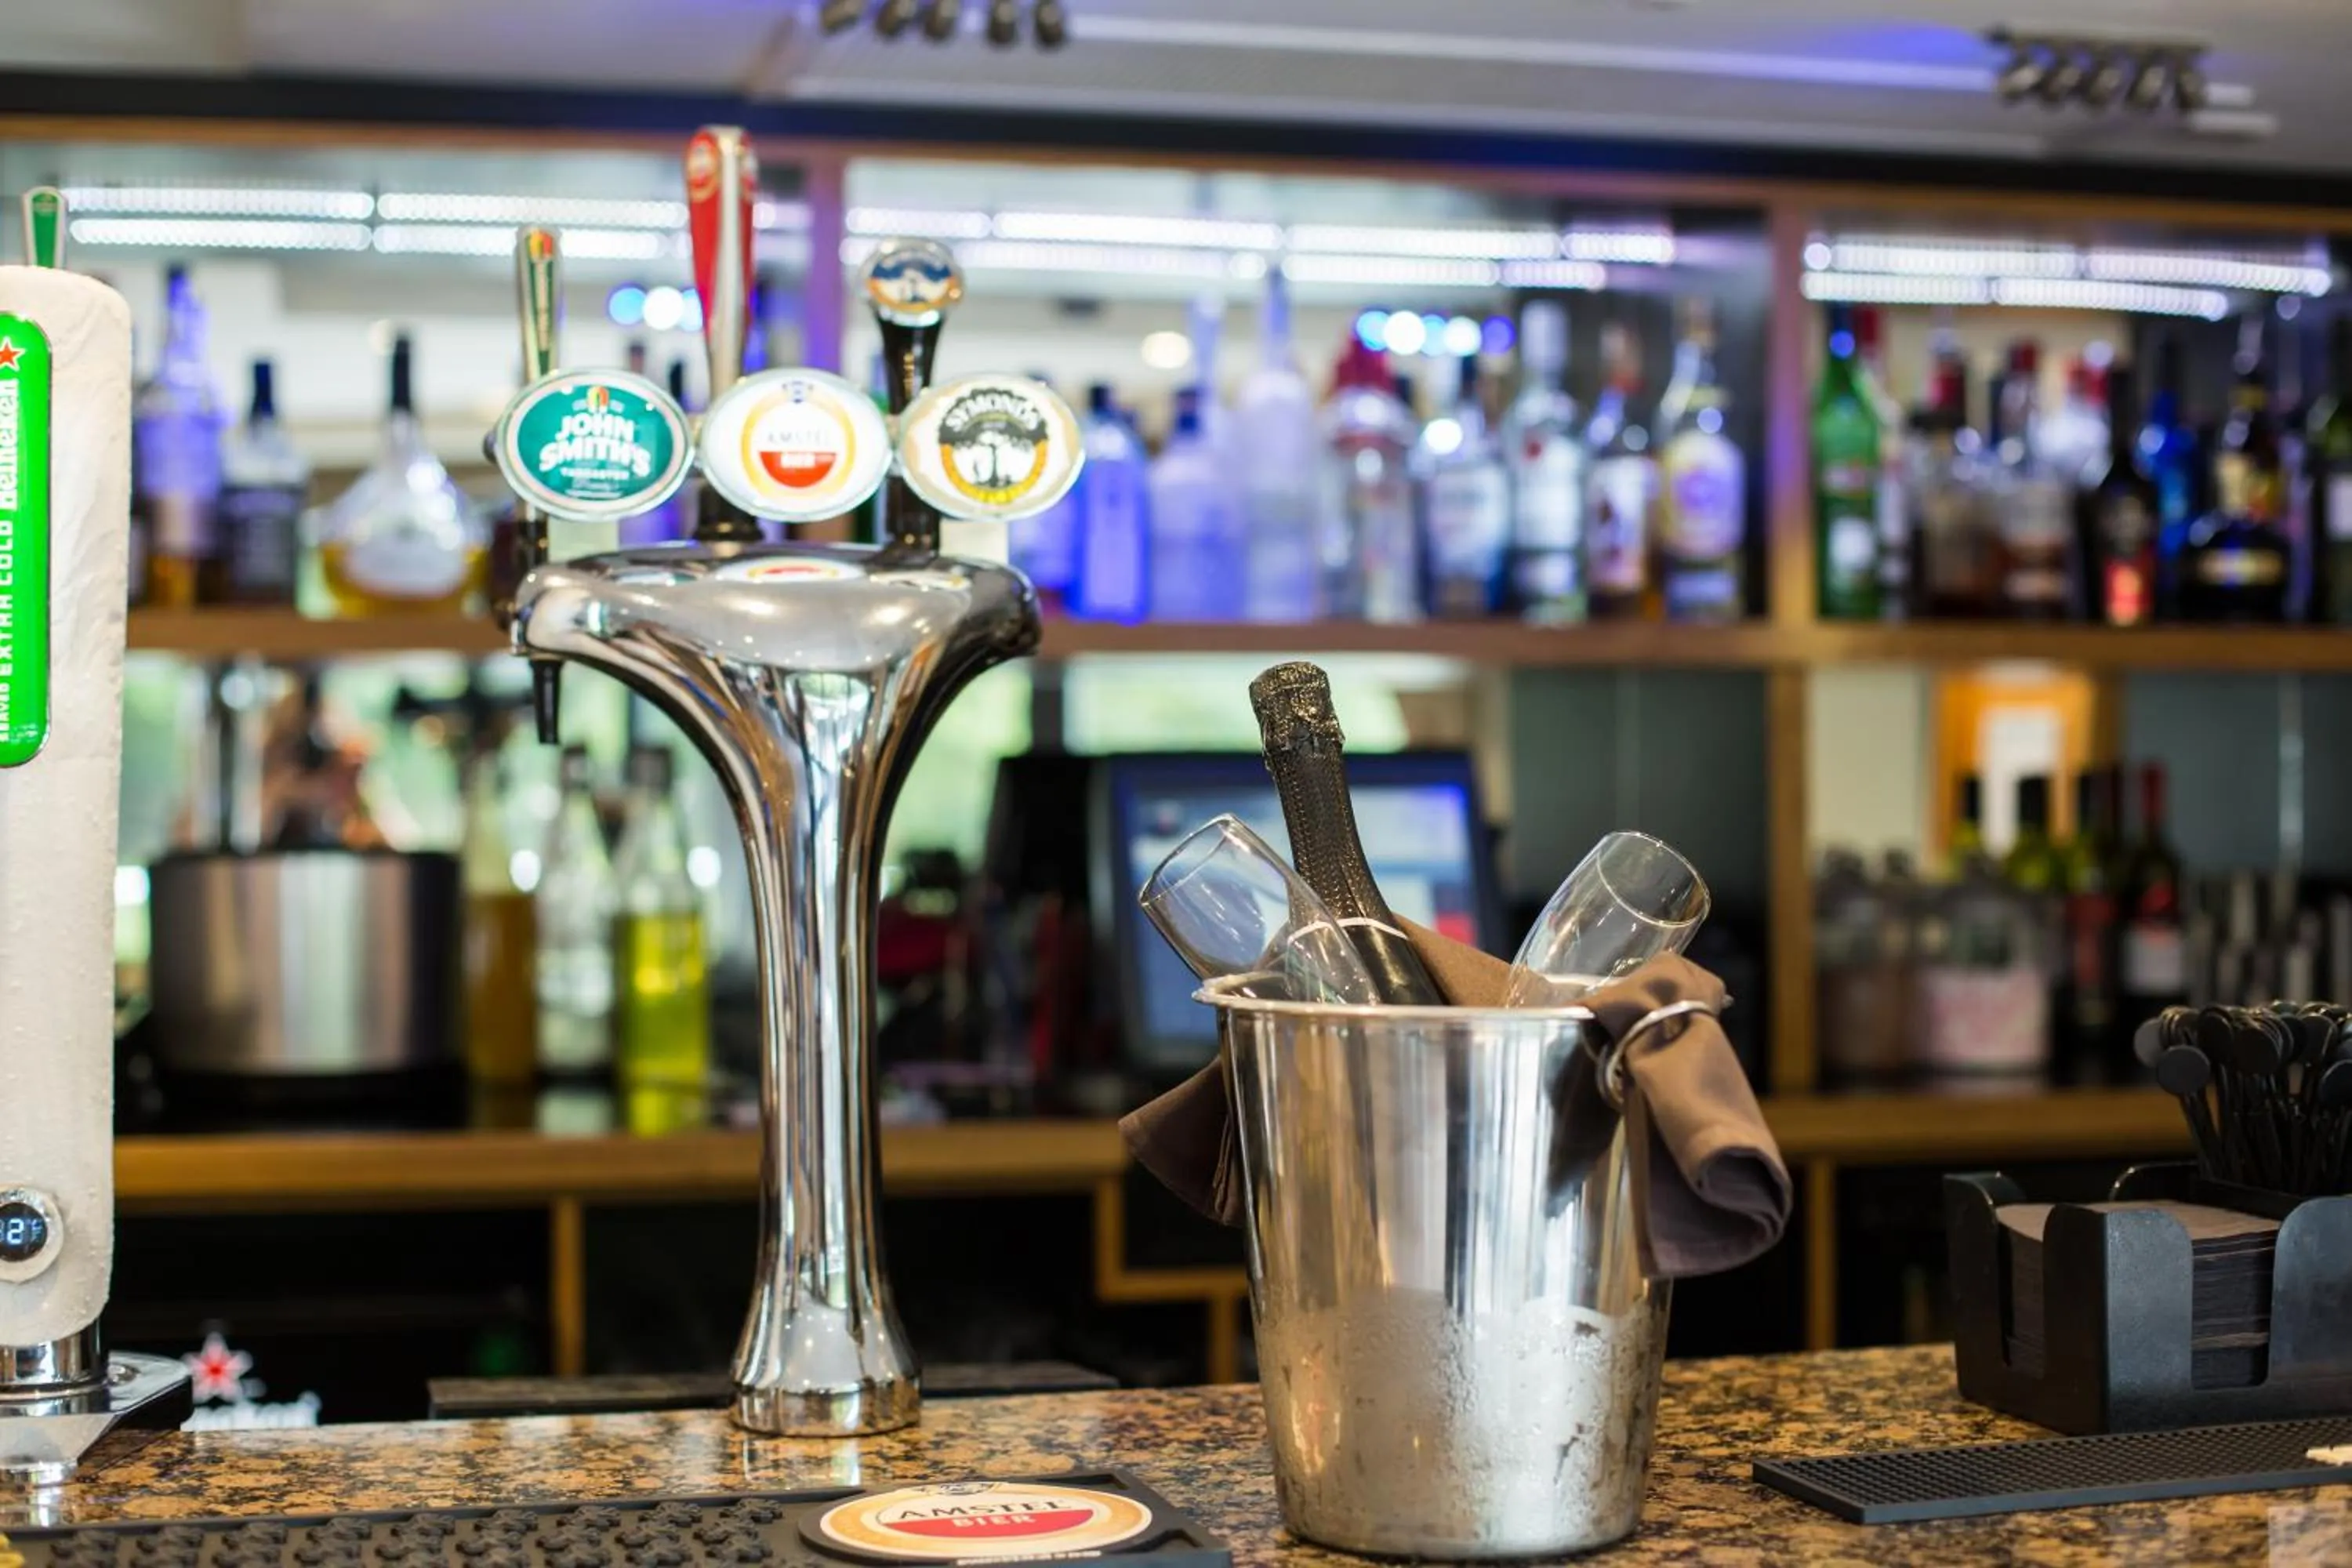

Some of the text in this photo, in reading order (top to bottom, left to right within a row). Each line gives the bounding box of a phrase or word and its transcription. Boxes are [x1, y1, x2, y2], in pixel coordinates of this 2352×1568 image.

[0, 379, 20, 510] Heineken
[554, 412, 635, 443] JOHN
[539, 436, 652, 477] SMITH'S
[0, 521, 13, 586] COLD
[0, 594, 13, 676] EXTRA
[901, 1500, 1071, 1519] AMSTEL
[951, 1514, 1036, 1528] BIER
